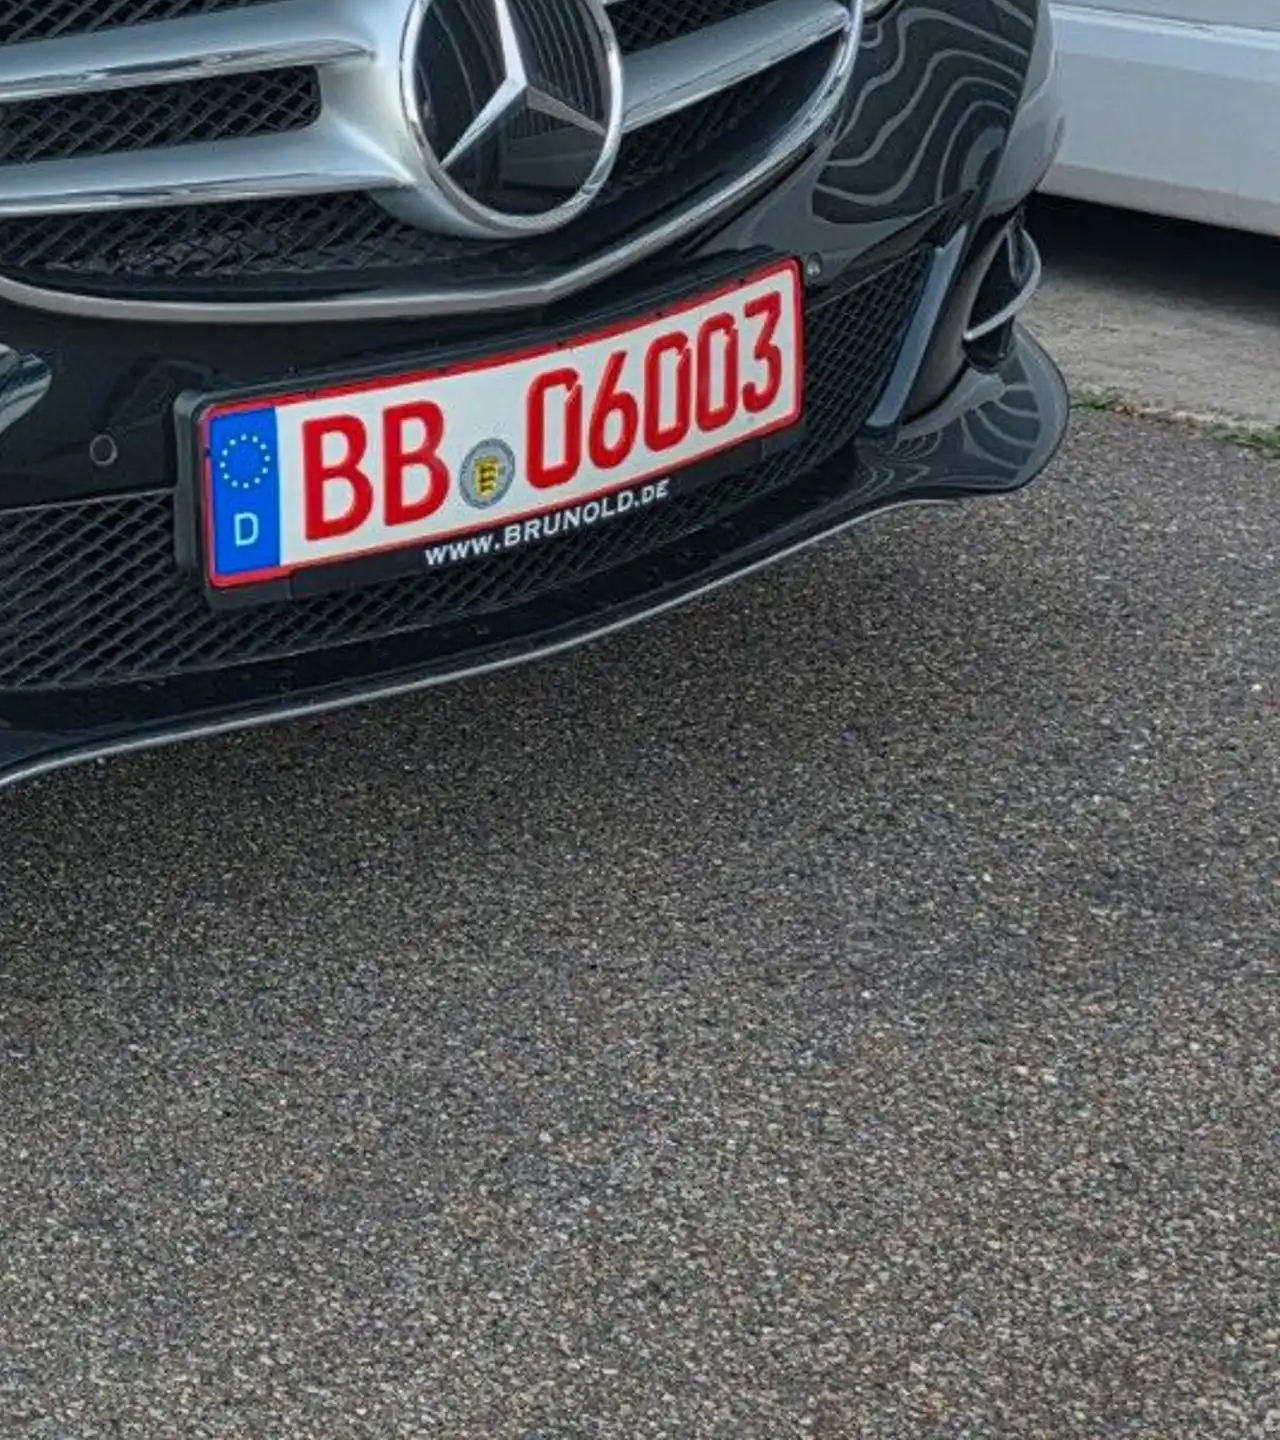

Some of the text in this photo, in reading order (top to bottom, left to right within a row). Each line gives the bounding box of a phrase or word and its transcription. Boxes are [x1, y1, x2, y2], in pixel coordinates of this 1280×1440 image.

[302, 291, 783, 542] BB 06003
[233, 512, 259, 547] D
[423, 478, 670, 567] WWW.BRUNOLD.DE
